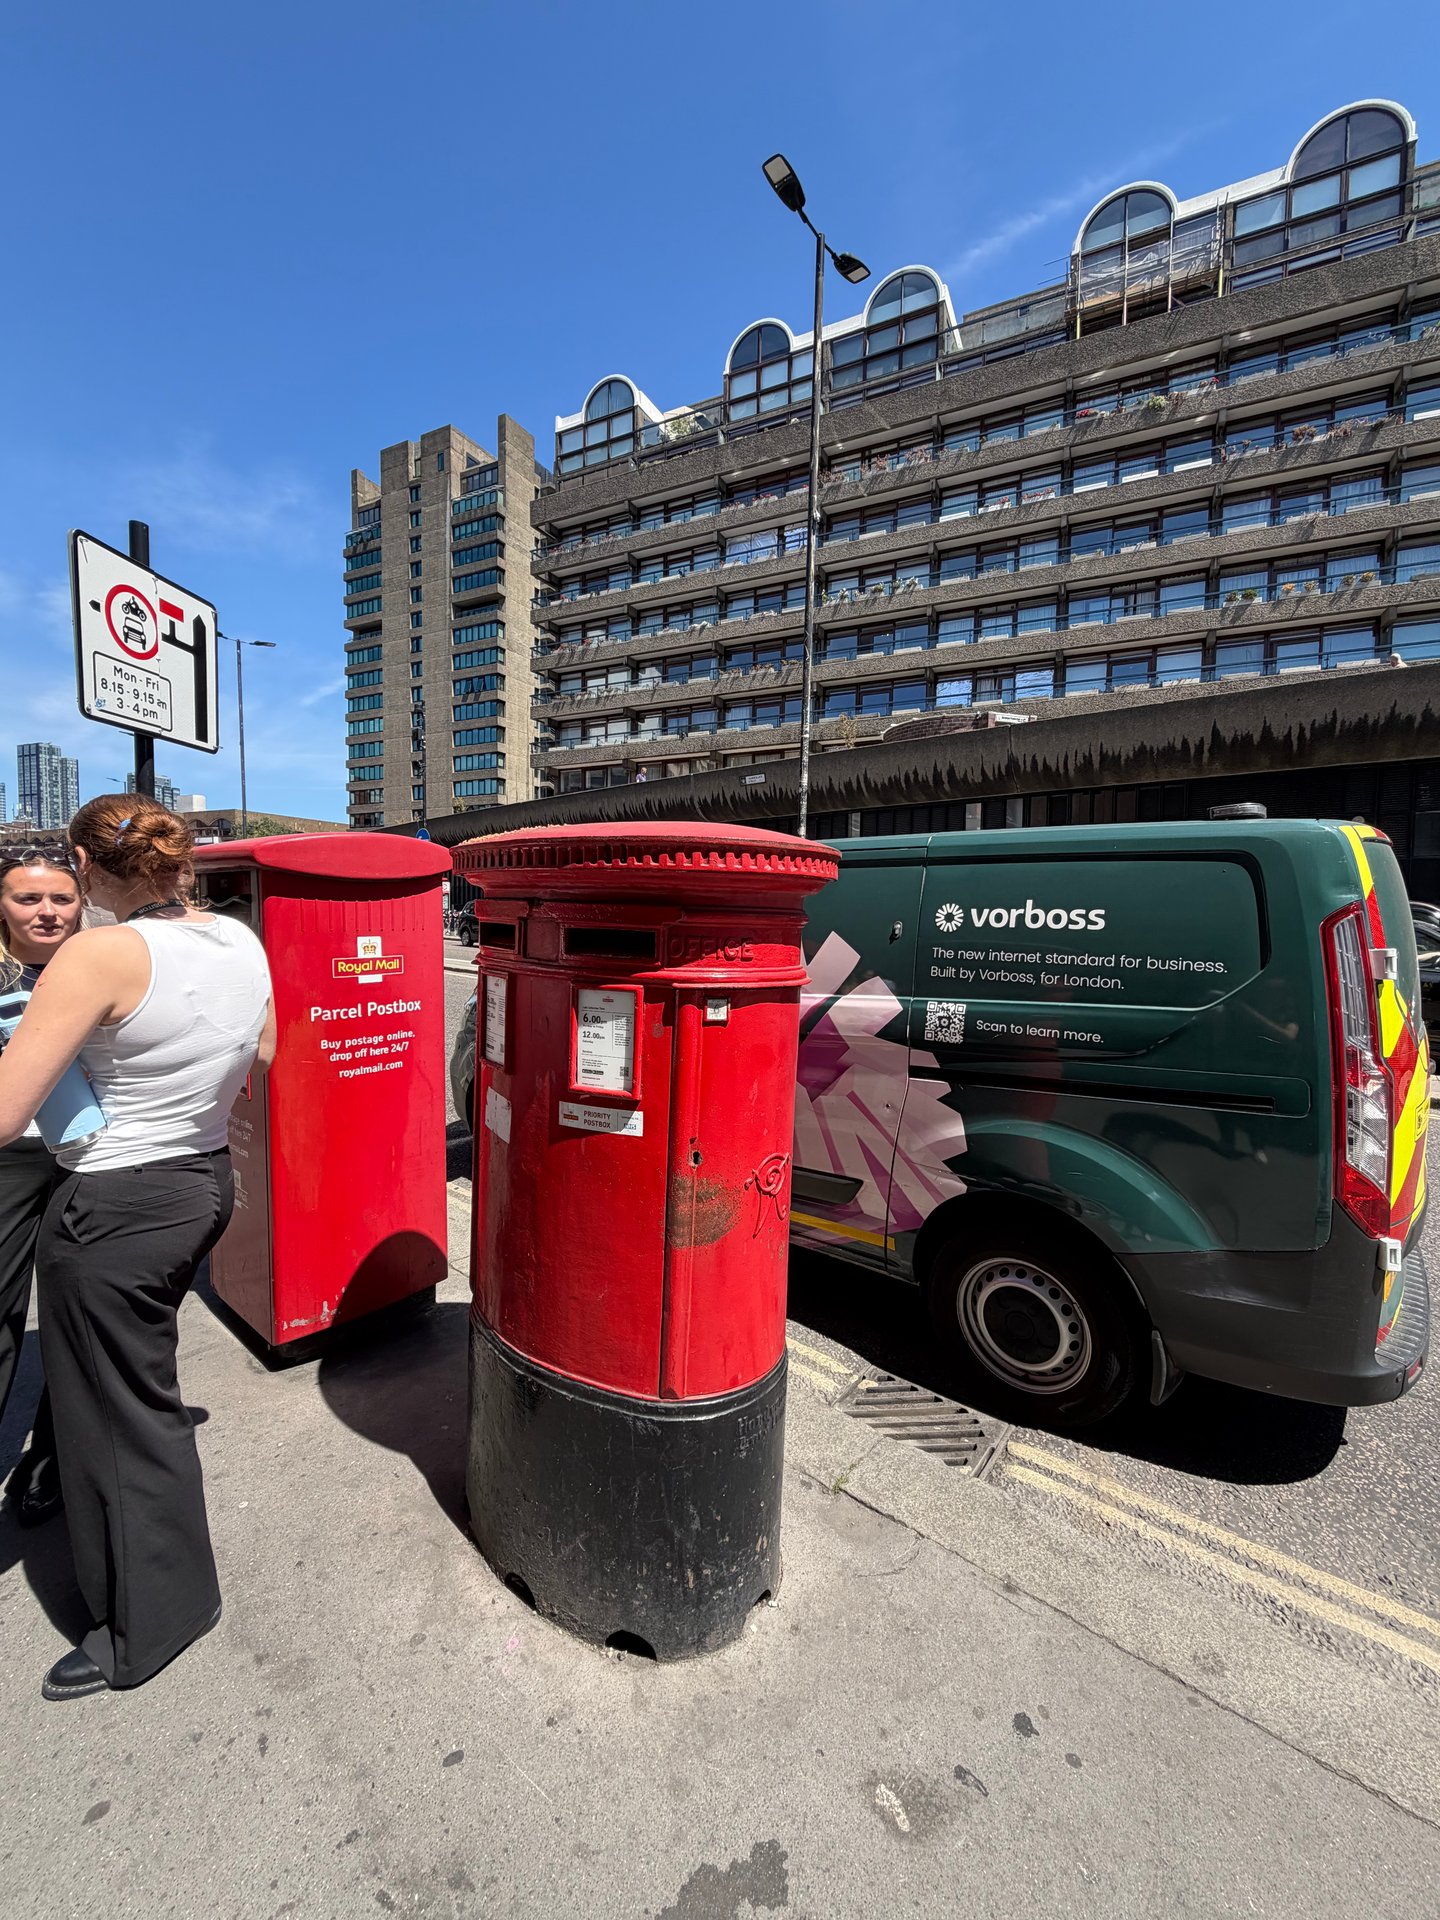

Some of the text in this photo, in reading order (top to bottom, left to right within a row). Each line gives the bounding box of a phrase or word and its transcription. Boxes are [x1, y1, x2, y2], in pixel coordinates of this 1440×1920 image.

[113, 665, 137, 683] Mon
[146, 677, 159, 691] Fri
[101, 678, 124, 695] 8.15
[133, 688, 155, 704] 9.15
[117, 697, 123, 709] 3
[132, 703, 140, 714] 4
[143, 707, 158, 720] pm
[970, 899, 1106, 931] vorboss
[670, 936, 754, 962] OFFICE
[932, 947, 1228, 973] The new internet standard for business.
[338, 958, 400, 974] Royal Mail
[930, 965, 1124, 989] Built by Vorboss, for London.
[310, 999, 421, 1022] Parcel Postbox
[320, 1039, 341, 1050] Buy
[345, 1035, 384, 1048] postage
[976, 1019, 1104, 1043] Scan to learn more.
[329, 1041, 409, 1062] drop off here 24/7
[339, 1061, 403, 1079] royalmail.com
[583, 1110, 611, 1120] PRIORITY
[583, 1118, 611, 1128] POSTBOX
